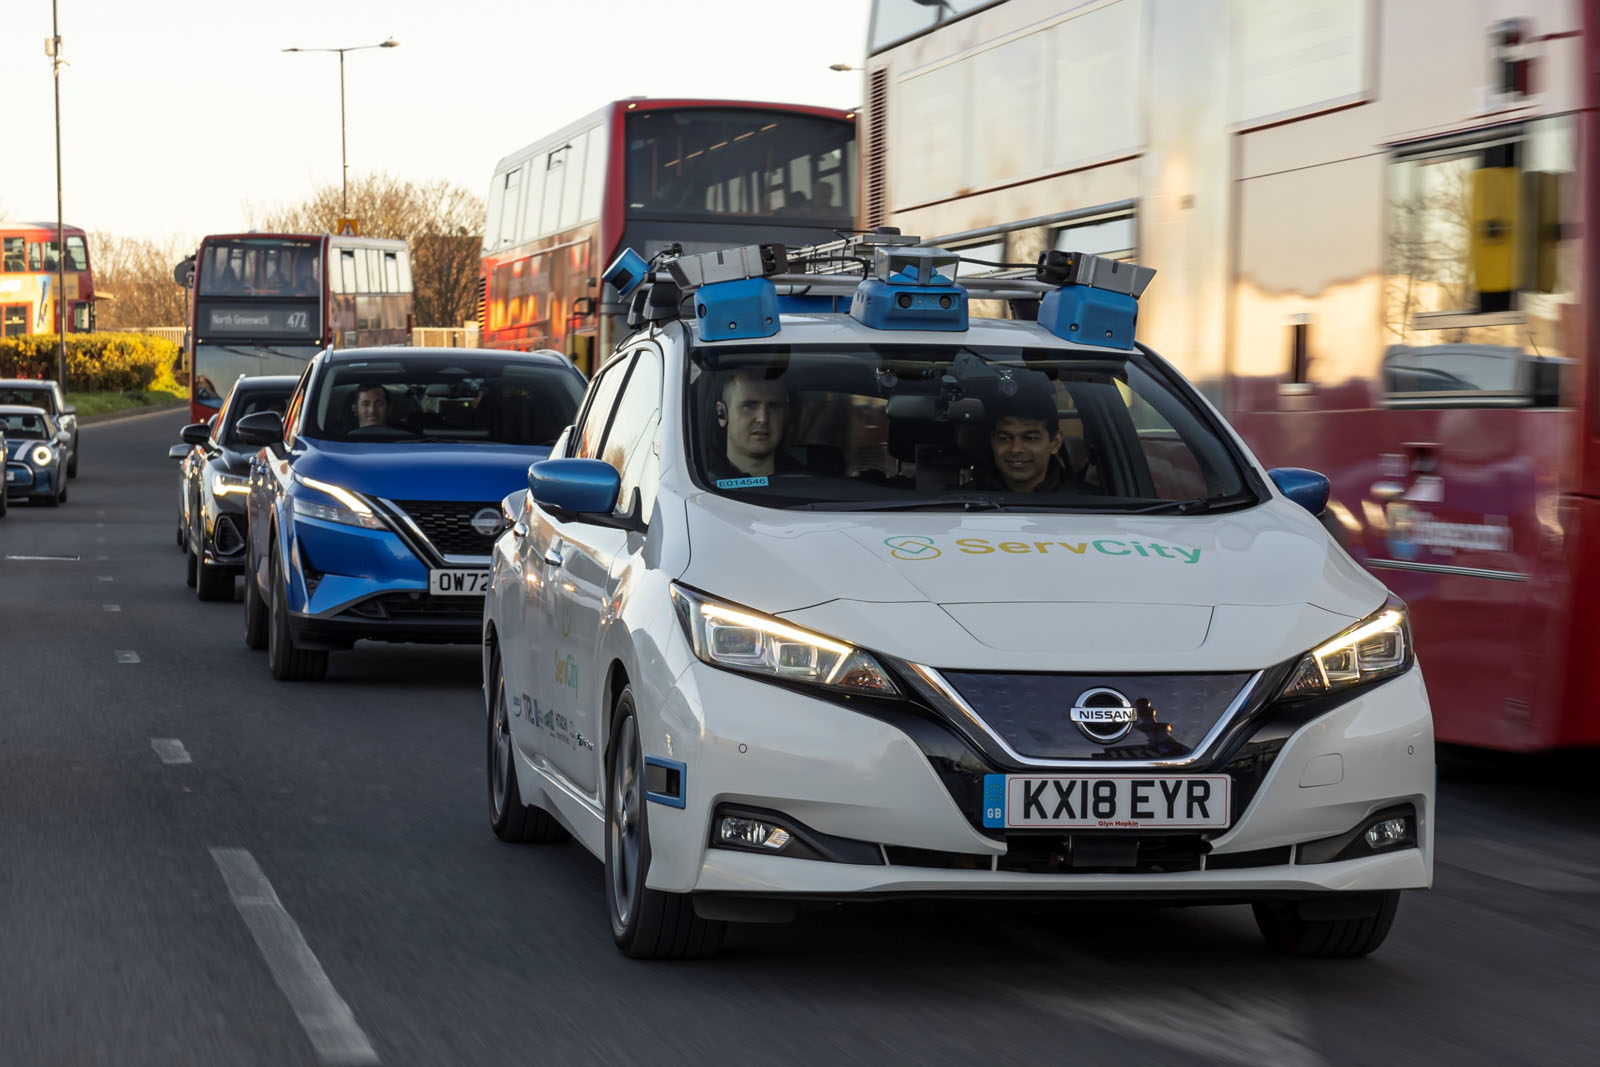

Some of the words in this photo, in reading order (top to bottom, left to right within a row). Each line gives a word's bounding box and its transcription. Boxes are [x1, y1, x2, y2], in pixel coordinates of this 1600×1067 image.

[212, 314, 232, 325] North
[233, 314, 268, 325] Greenwich
[287, 311, 307, 328] 472
[955, 538, 1201, 563] ServCity
[439, 573, 489, 591] OW72
[1079, 710, 1132, 720] NISSAN
[1023, 780, 1117, 819] KX18
[1130, 780, 1211, 819] EYR
[986, 807, 1002, 819] GB
[1098, 820, 1114, 828] Glyn
